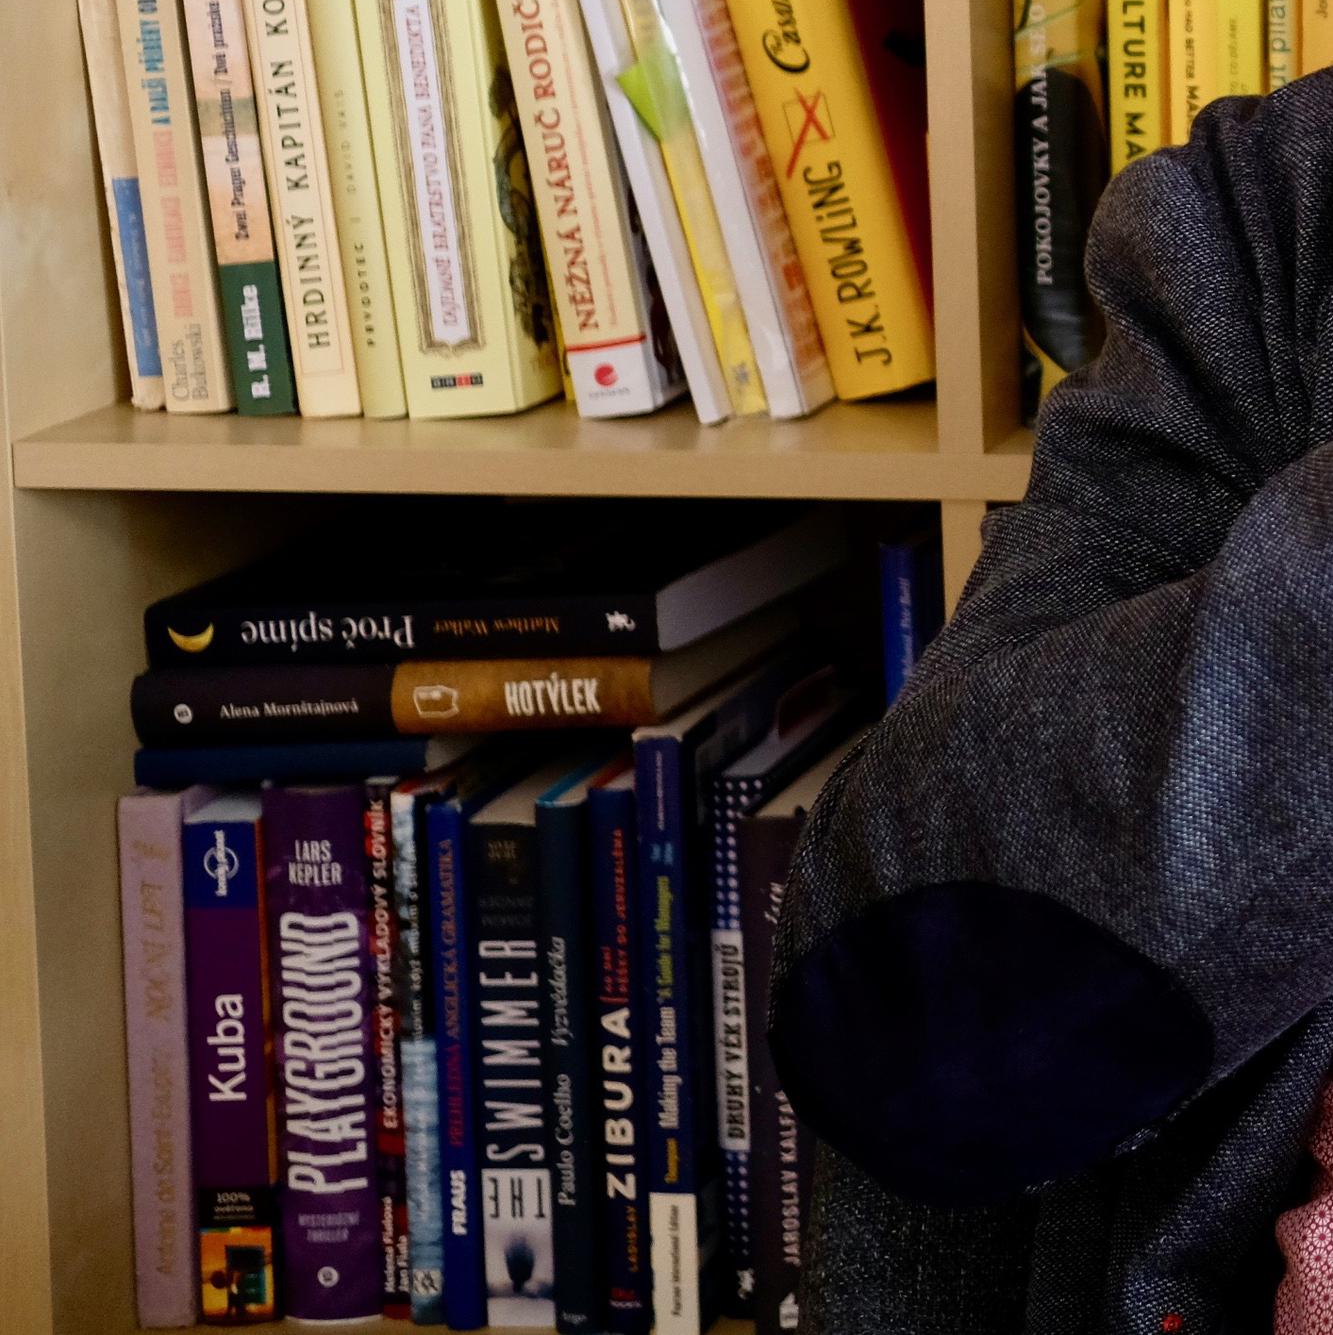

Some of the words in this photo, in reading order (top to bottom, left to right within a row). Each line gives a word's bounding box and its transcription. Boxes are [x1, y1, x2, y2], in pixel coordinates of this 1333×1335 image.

[270, 59, 311, 192] KAPITÁN
[534, 108, 583, 225] NÁRUČ
[288, 213, 331, 351] HRDINNÝ
[554, 227, 600, 333] NĚŽNÁ
[504, 672, 599, 717] HOTÝLEK
[287, 862, 343, 887] KEPLER
[294, 839, 331, 865] LARS
[208, 992, 248, 1103] Kuba
[279, 910, 369, 1195] PLAYGROUND
[478, 939, 546, 1164] SWIMMER
[600, 1006, 638, 1200] ZIBURA
[451, 1169, 467, 1236] FRAUS
